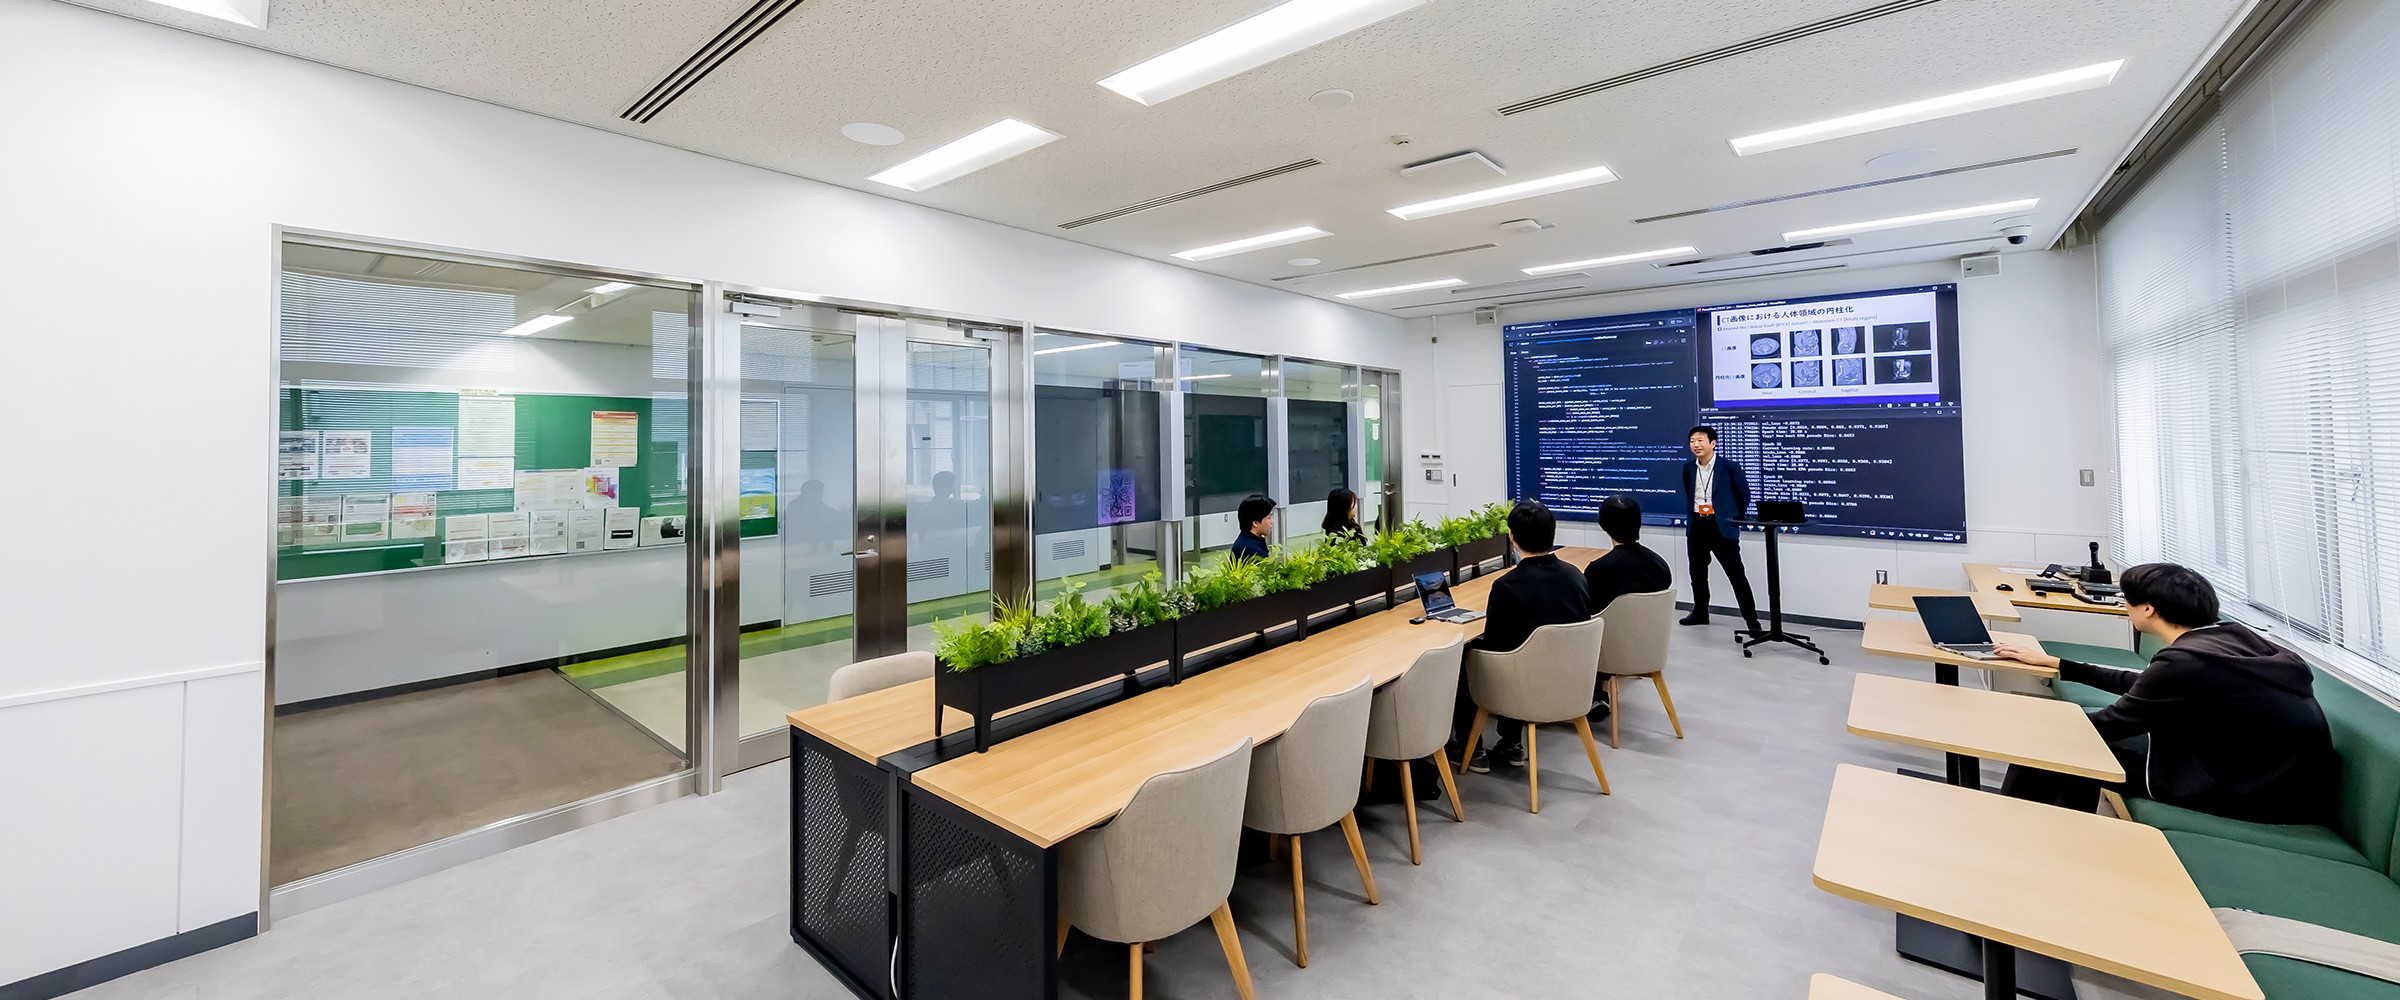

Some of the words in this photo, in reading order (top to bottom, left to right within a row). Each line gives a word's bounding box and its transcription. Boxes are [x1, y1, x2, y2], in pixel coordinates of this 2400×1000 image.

[1721, 306, 1854, 323] CT画像における人体領域の円柱化
